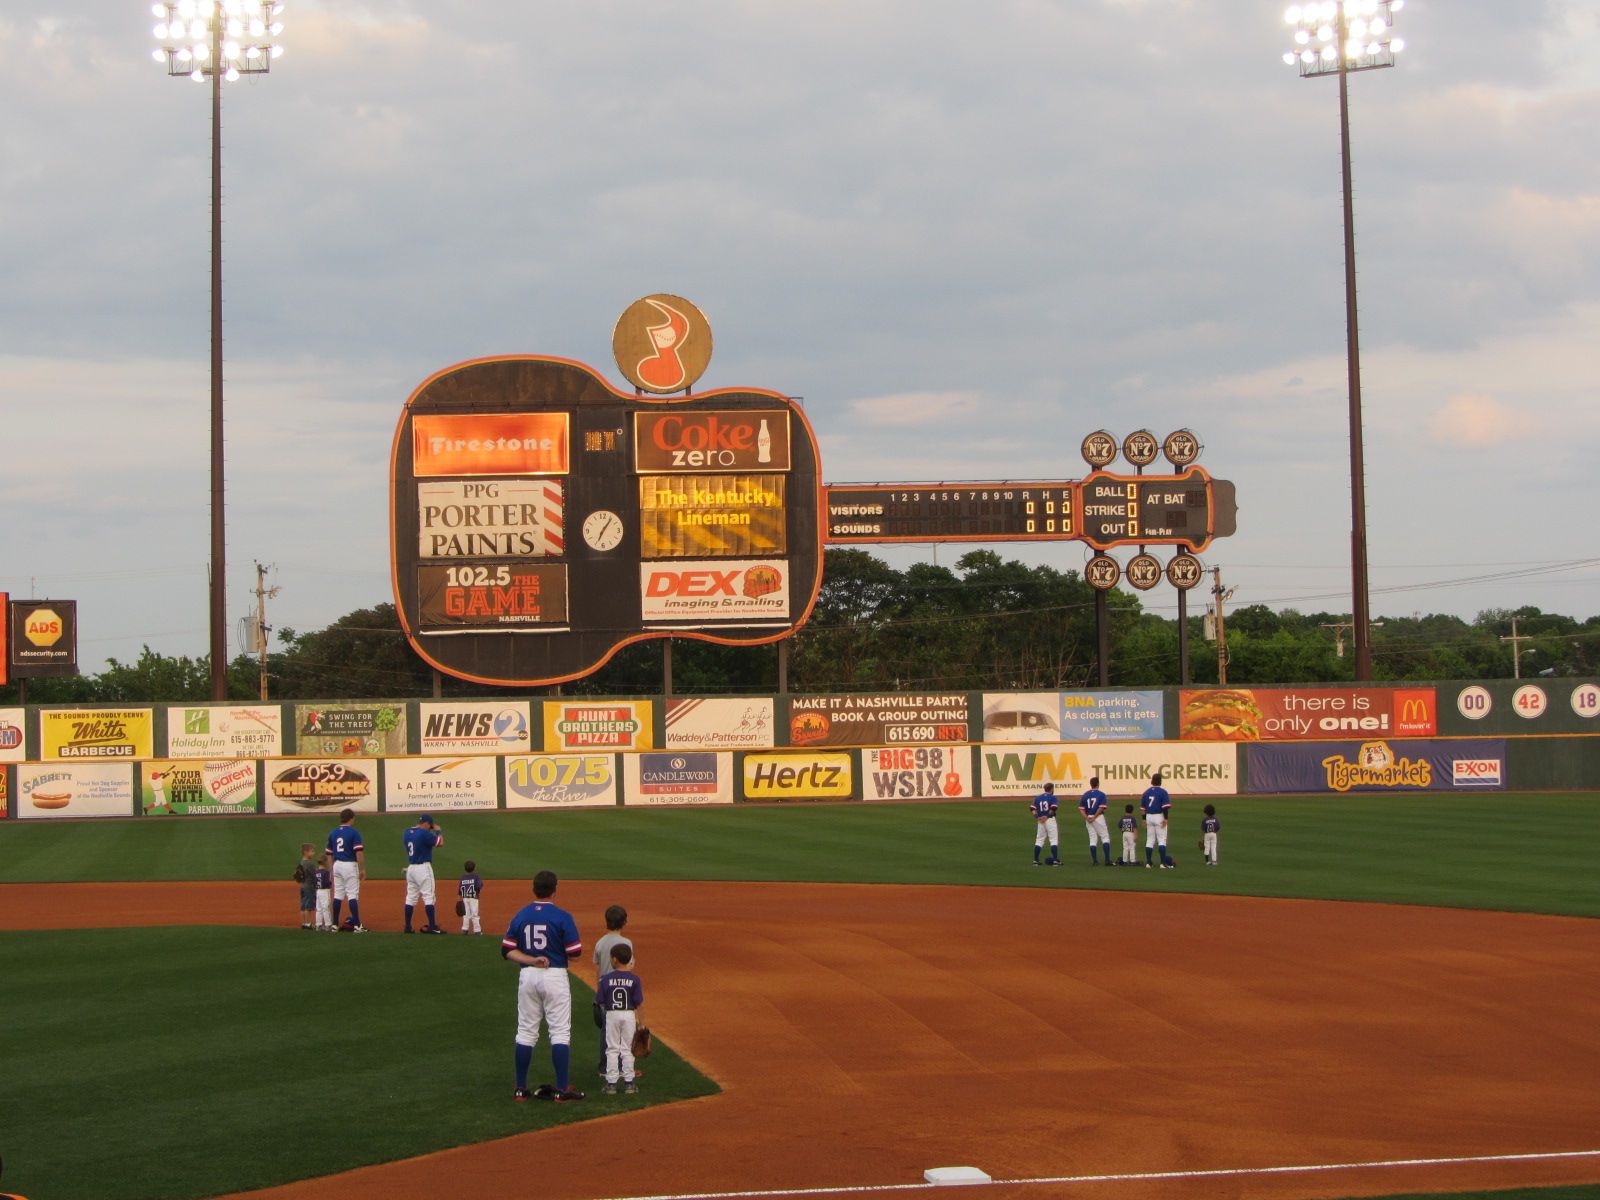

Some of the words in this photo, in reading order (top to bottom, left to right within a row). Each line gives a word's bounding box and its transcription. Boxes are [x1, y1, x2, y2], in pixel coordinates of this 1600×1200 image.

[652, 415, 754, 450] Coke
[430, 437, 552, 455] Firestone
[671, 450, 736, 467] zero
[463, 484, 499, 498] PPG
[656, 490, 688, 505] The
[694, 489, 774, 507] Kentucky
[890, 494, 896, 502] 1
[902, 493, 908, 502] 2
[913, 493, 920, 502] 3
[930, 493, 936, 501] 4
[941, 492, 948, 501] 5
[953, 492, 960, 501] 6
[969, 492, 976, 500] 7
[982, 492, 988, 500] 8
[993, 492, 1000, 500] 9
[1004, 491, 1013, 500] 10
[1022, 491, 1030, 500] R
[1042, 490, 1050, 499] H
[1062, 490, 1070, 499] E
[1096, 486, 1125, 497] BALL
[1147, 494, 1160, 504] AT
[1164, 493, 1186, 504] BAT
[424, 504, 539, 528] PORTER
[830, 506, 883, 515] VISITORS
[1085, 505, 1125, 516] STRIKE
[677, 511, 750, 526] Lineman
[833, 525, 880, 534] SOUNDS
[1101, 523, 1125, 534] OUT
[431, 532, 535, 556] PAINTS
[446, 567, 511, 586] 102.5
[513, 575, 540, 585] THE
[645, 571, 743, 597] DEX
[445, 586, 541, 616] GAME
[664, 599, 719, 608] imaging
[734, 598, 784, 607] mailing
[29, 621, 59, 634] ADS
[793, 699, 826, 709] MAKE
[830, 698, 841, 708] IT
[846, 698, 852, 708] A
[857, 697, 922, 707] NASHVILLE
[926, 696, 968, 706] PARTY.
[1064, 696, 1095, 708] BNA
[1283, 694, 1346, 710] there
[1353, 694, 1370, 710] is
[1464, 695, 1485, 710] 00
[1518, 693, 1540, 709] 42
[1579, 692, 1597, 708] 18
[578, 710, 618, 721] HUNT
[831, 713, 864, 722] BOOK
[867, 712, 875, 721] A
[878, 711, 917, 721] GROUP
[920, 710, 968, 720] OUTING!
[1065, 711, 1077, 719] As
[1080, 711, 1106, 719] close
[1124, 710, 1132, 718] it
[424, 713, 493, 737] NEWS
[562, 722, 634, 732] BROTHERS
[1265, 715, 1312, 734] only
[1319, 714, 1389, 730] one!
[171, 737, 209, 748] Holiday
[210, 737, 225, 745] Inn
[578, 732, 619, 743] PIZZA
[61, 746, 133, 756] BARBECUE
[871, 750, 879, 763] THE
[879, 749, 914, 770] BIG
[915, 748, 943, 769] 98
[985, 752, 1082, 781] WM
[297, 764, 345, 781] 105.9
[509, 757, 608, 786] 107.5
[643, 772, 714, 780] CANDLEWOOD
[752, 762, 841, 789] Hertz
[1091, 764, 1152, 780] THINK
[1325, 757, 1429, 788] Tigermarket
[1455, 761, 1497, 776] EXXON
[22, 773, 72, 794] SABRETT
[211, 765, 253, 793] parent
[421, 781, 481, 789] FITNESS
[872, 771, 943, 797] WSIX
[272, 781, 310, 796] THE
[314, 781, 370, 795] ROCK
[171, 791, 202, 802] HIT!
[1087, 798, 1097, 808] 17
[1148, 796, 1155, 807] 7
[1039, 801, 1049, 811] 13
[336, 838, 345, 852] 2
[407, 842, 414, 856] 3
[460, 884, 476, 898] 14
[524, 924, 548, 950] 15
[609, 979, 634, 987] NATHAN
[612, 987, 628, 1010] 9
